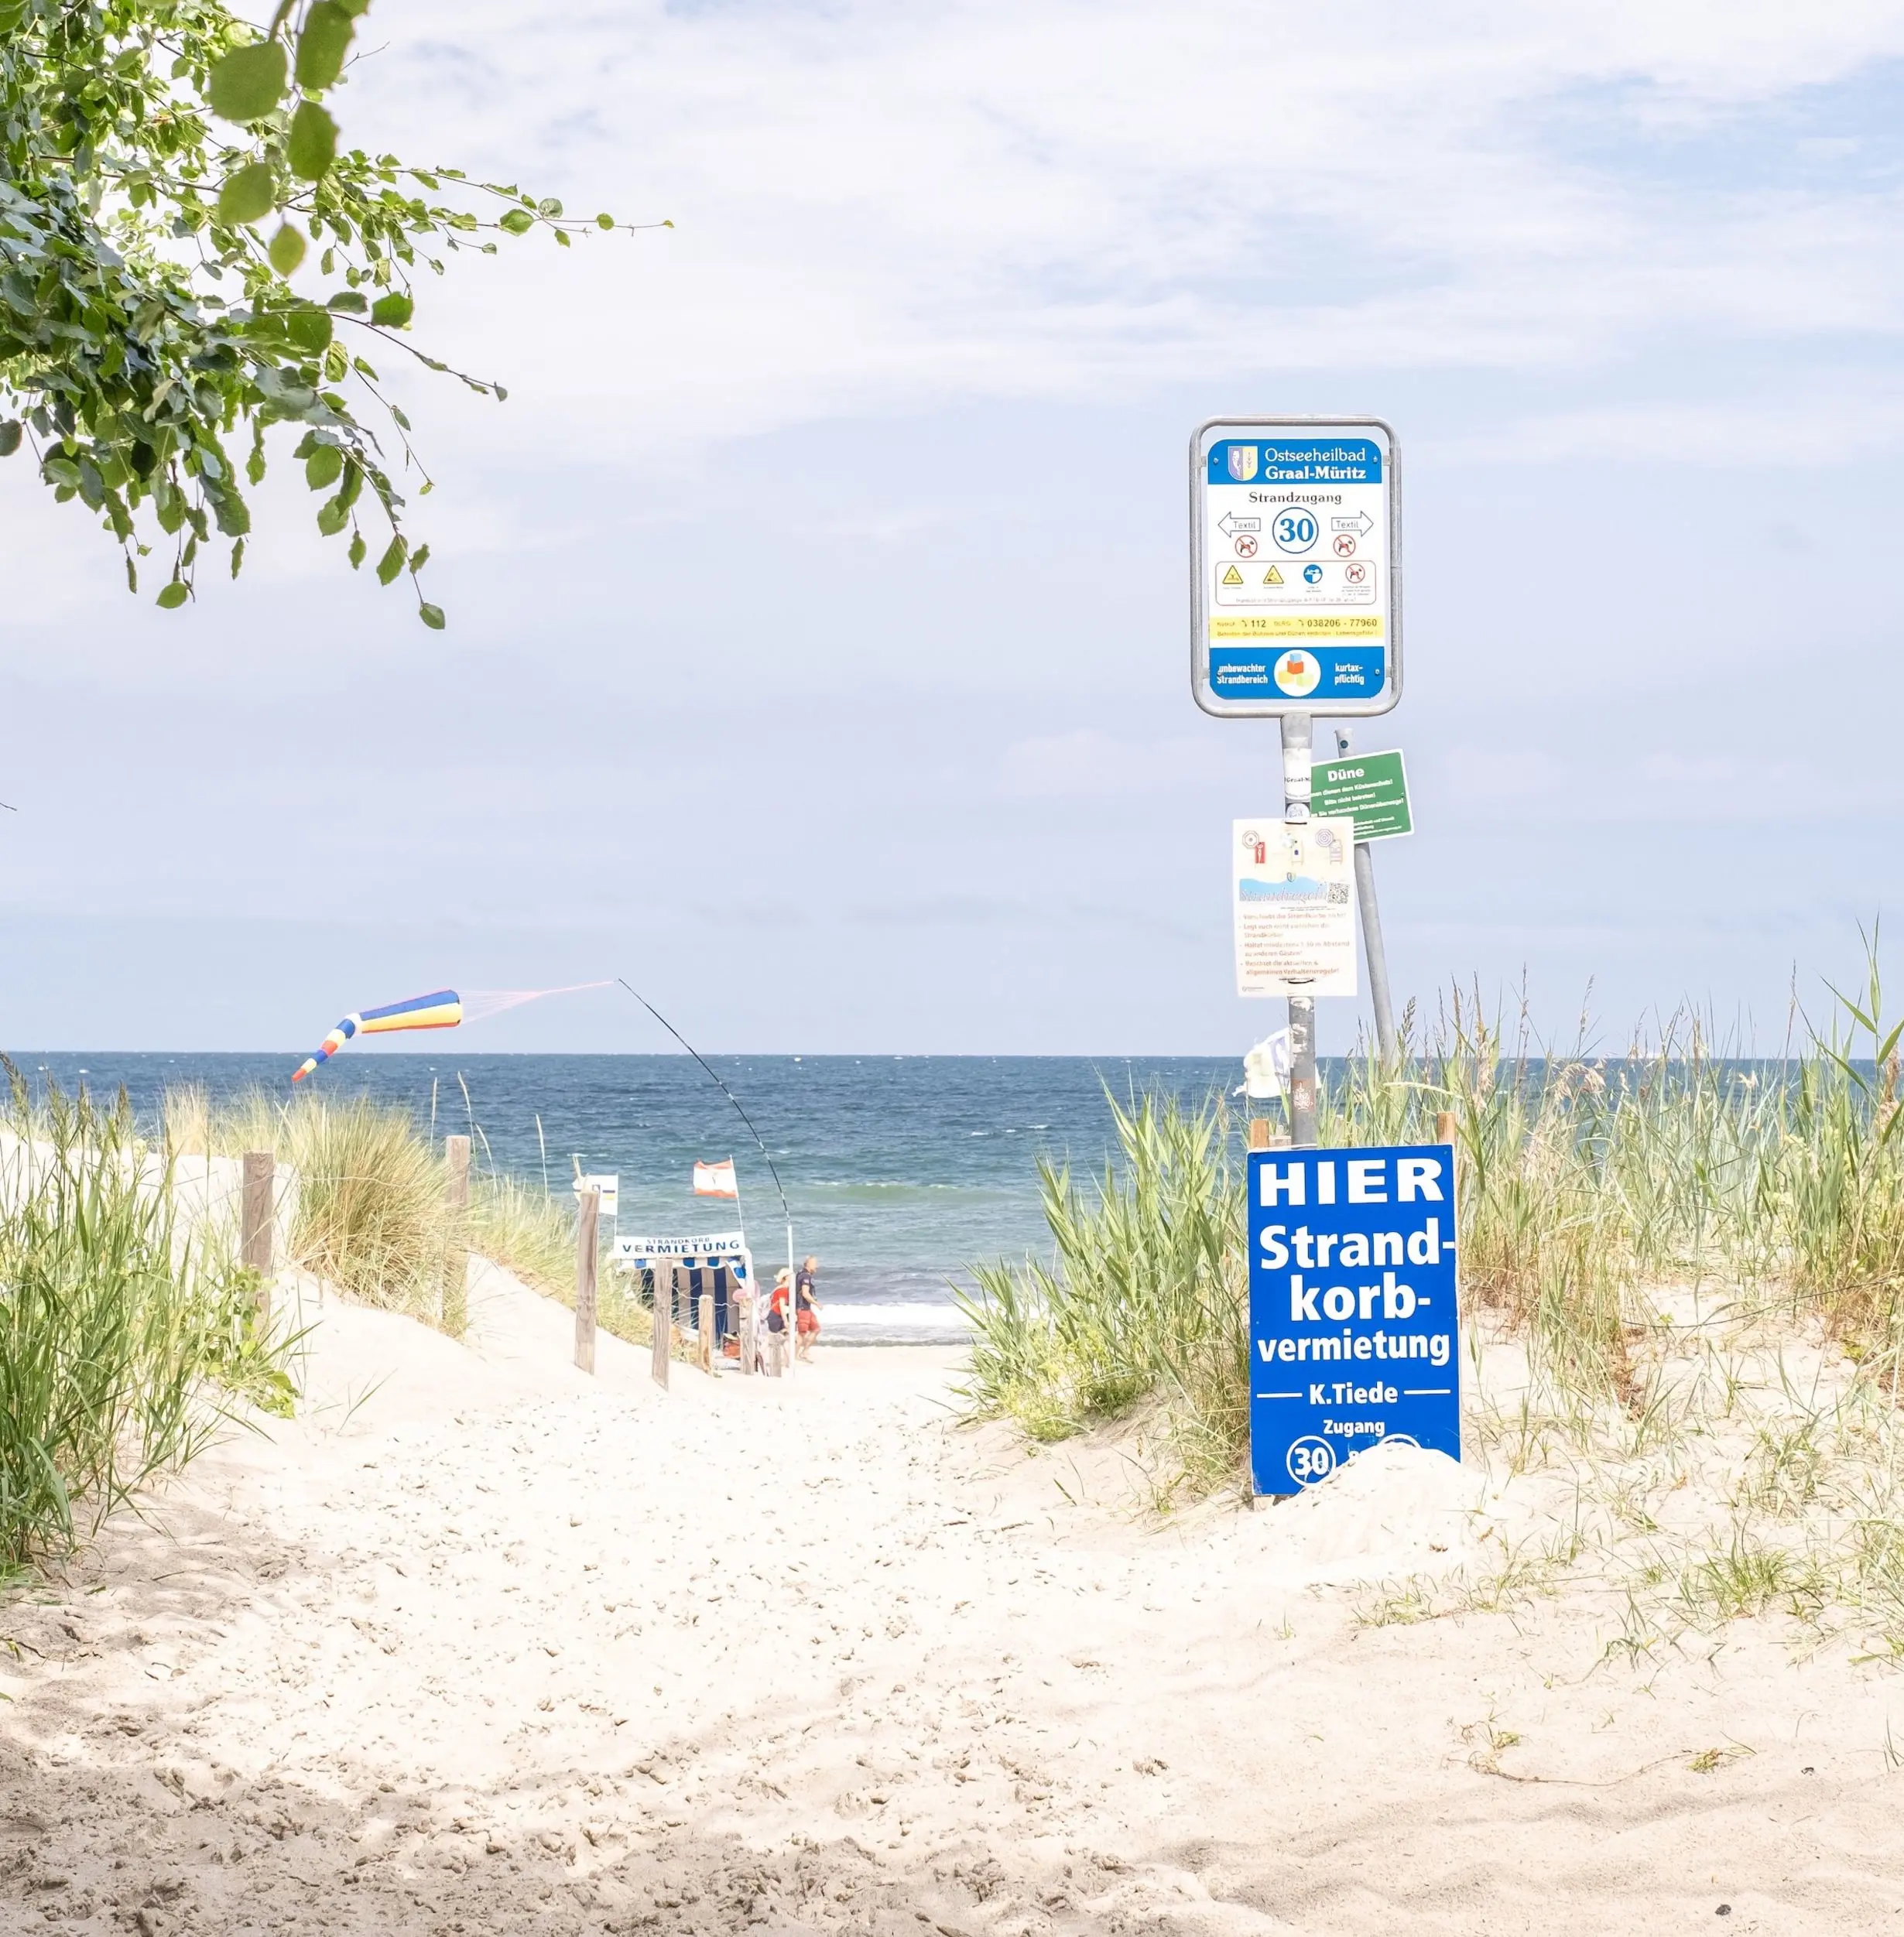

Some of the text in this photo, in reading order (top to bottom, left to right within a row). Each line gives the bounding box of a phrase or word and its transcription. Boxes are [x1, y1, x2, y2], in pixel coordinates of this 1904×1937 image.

[1265, 447, 1366, 462] Ostseeheilbad
[1265, 465, 1366, 480] Graal-Müritz
[1248, 491, 1342, 505] Strandzugang
[1233, 521, 1256, 529] Textil
[1279, 518, 1314, 542] 30
[1336, 520, 1359, 529] Textil
[1251, 619, 1266, 628] 112
[1306, 619, 1341, 628] 038206
[1349, 618, 1378, 627] 77960
[1218, 663, 1266, 673] unbewachter
[1334, 662, 1363, 672] kurtax-
[1217, 675, 1268, 685] Strandbereich
[1334, 674, 1365, 686] pflichtig
[1327, 768, 1365, 782] Düne
[1259, 1158, 1445, 1207] HIER
[622, 1240, 740, 1254] VERMIETUNG
[1259, 1217, 1456, 1270] Strand-
[1289, 1271, 1432, 1322] korb-
[1257, 1328, 1450, 1367] vermietung
[1309, 1381, 1399, 1405] K.Tiede
[1323, 1419, 1385, 1438] Zugang
[1293, 1446, 1330, 1476] 30
